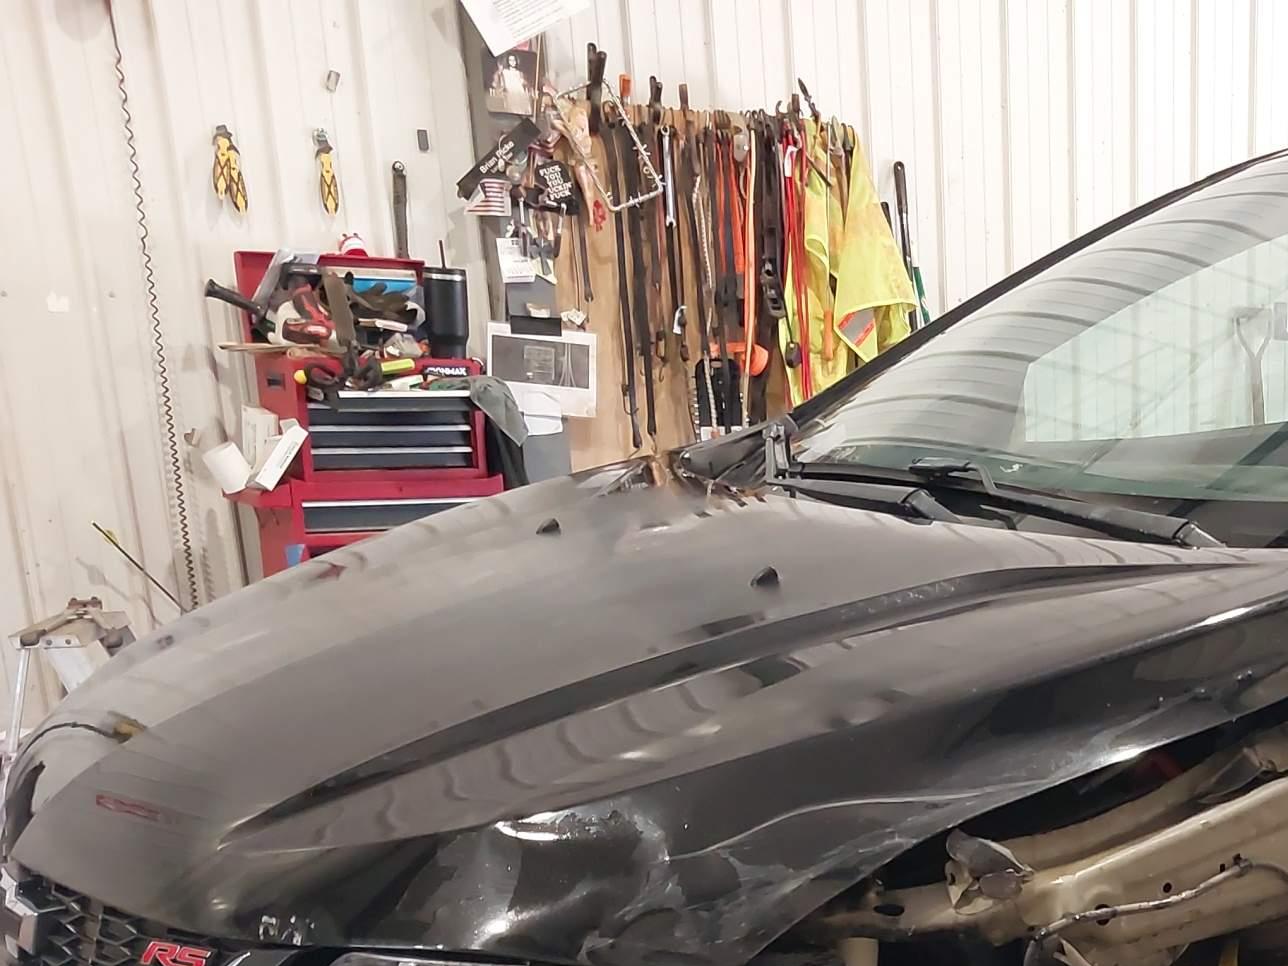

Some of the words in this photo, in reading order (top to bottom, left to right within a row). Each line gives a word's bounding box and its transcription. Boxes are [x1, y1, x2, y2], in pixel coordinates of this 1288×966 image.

[479, 156, 498, 174] Brian
[539, 165, 562, 177] FUCK
[544, 172, 561, 181] YOU
[547, 178, 564, 188] YOU
[549, 189, 572, 201] FUCK
